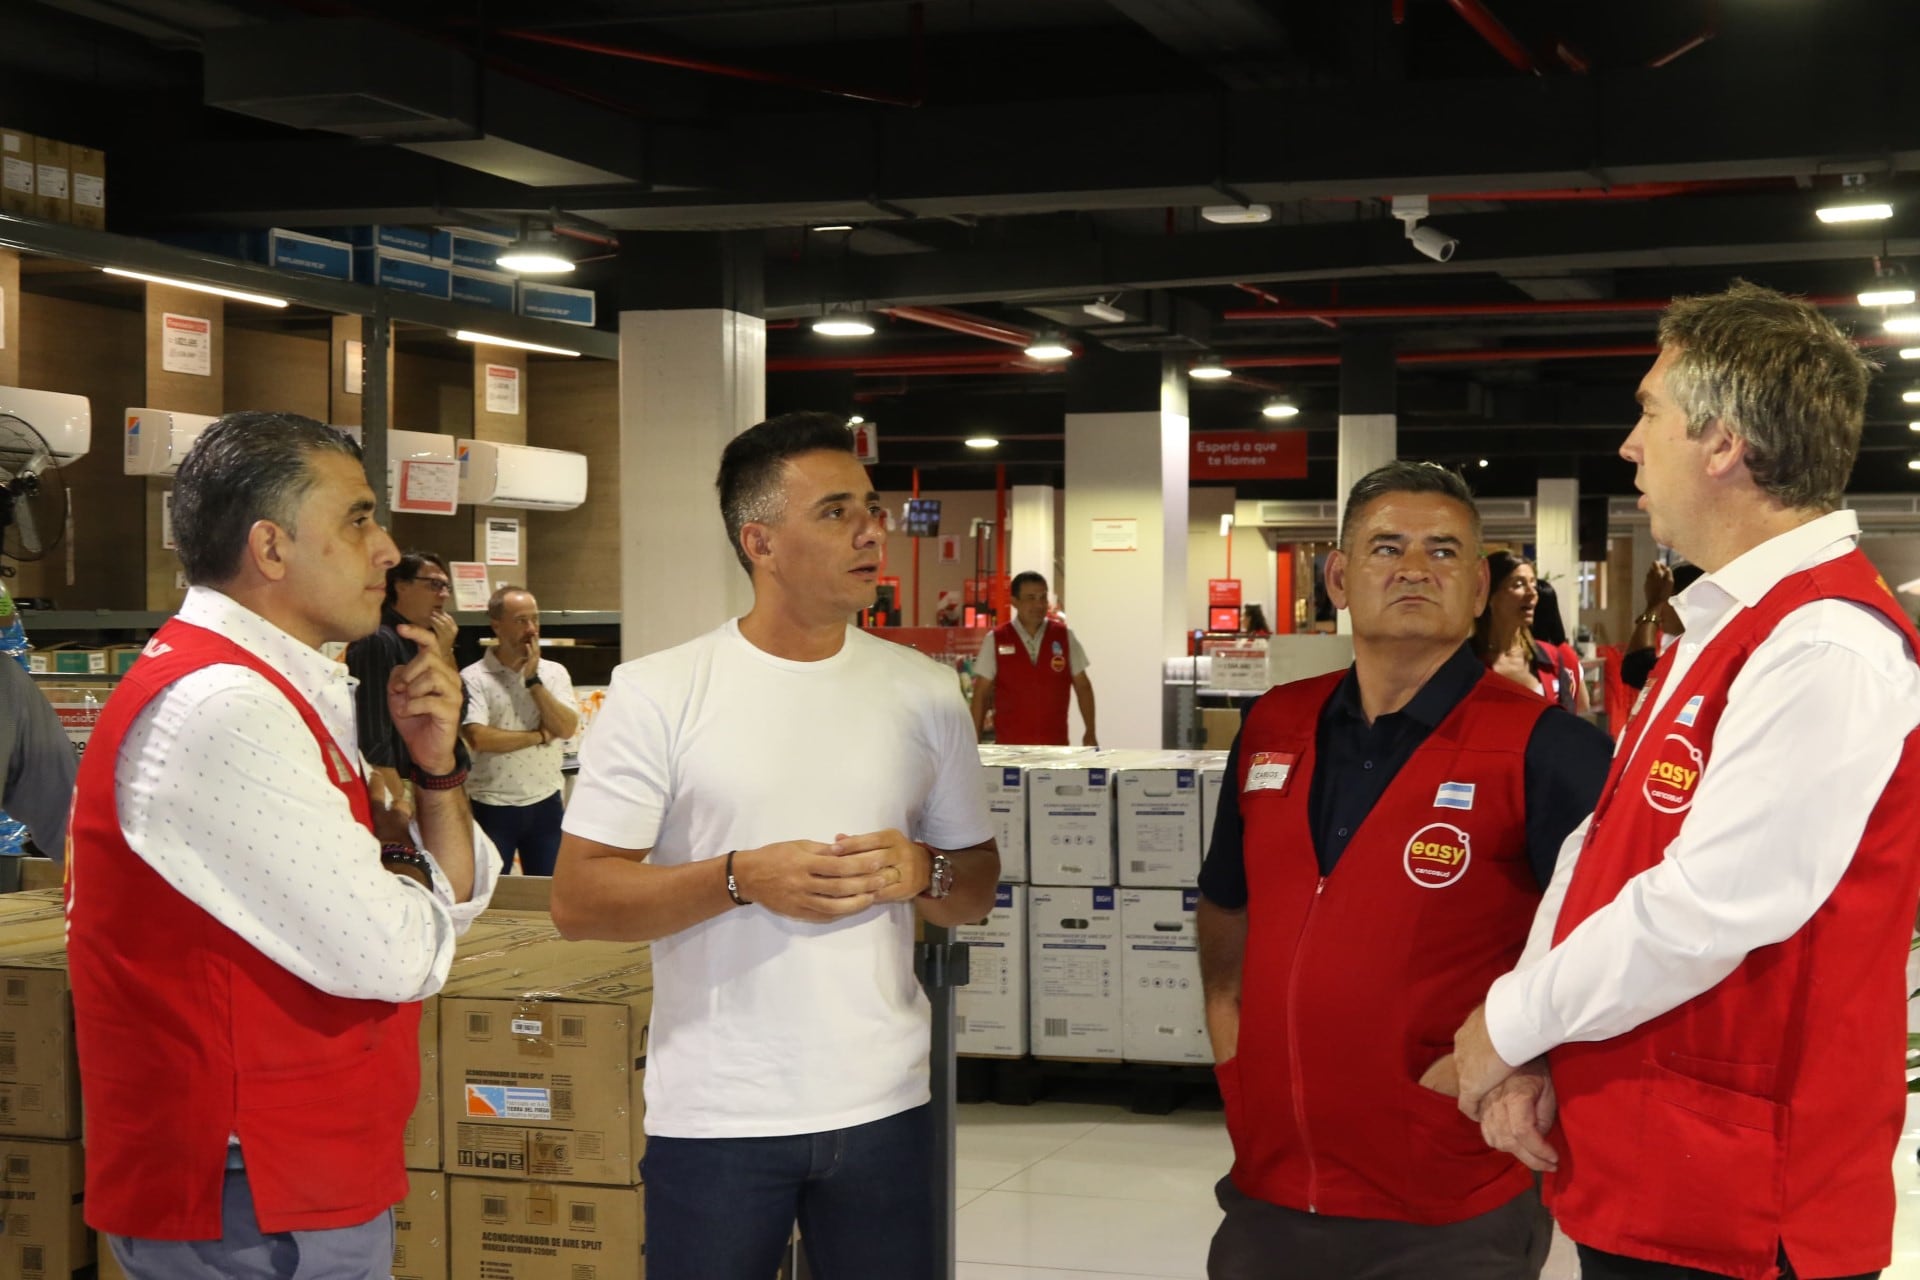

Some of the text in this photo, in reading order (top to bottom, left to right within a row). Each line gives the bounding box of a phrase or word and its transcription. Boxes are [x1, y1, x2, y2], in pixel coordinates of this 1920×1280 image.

[1197, 442, 1240, 453] Esperá
[1255, 443, 1277, 453] que
[1208, 455, 1265, 465] te llamen
[1650, 760, 1699, 791] easy
[1411, 840, 1466, 866] easy
[482, 1232, 602, 1251] ACONDICIONADOR DE AIRE SPLIT
